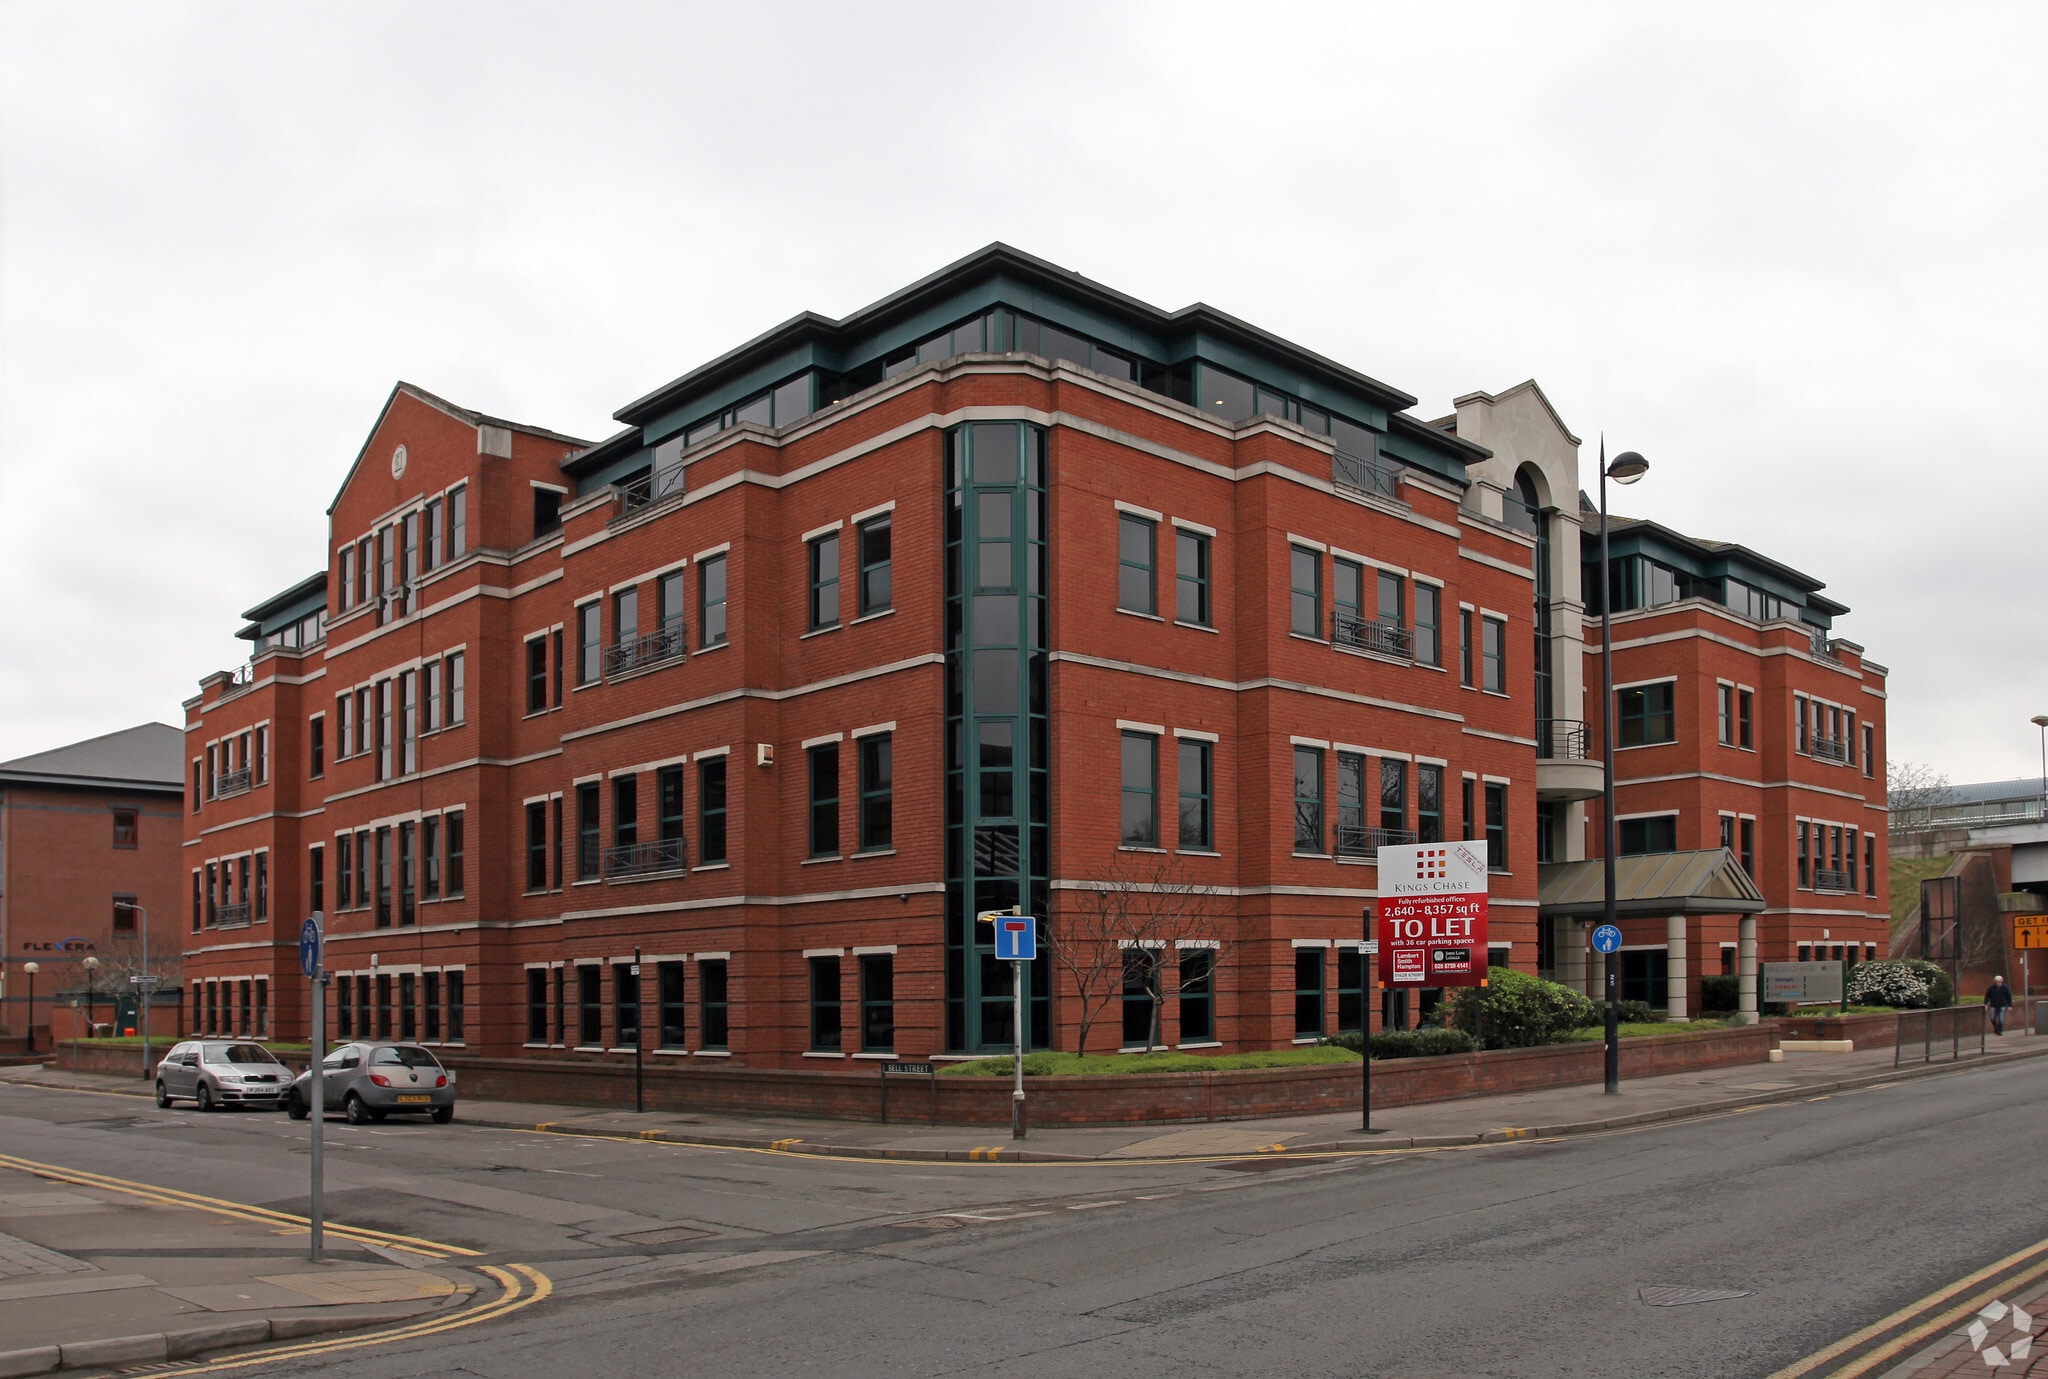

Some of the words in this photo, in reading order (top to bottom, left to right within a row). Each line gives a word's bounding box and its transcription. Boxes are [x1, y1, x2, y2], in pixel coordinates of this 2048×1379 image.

[1456, 846, 1484, 873] TESLA
[1395, 883, 1428, 893] KINGS
[1433, 881, 1470, 890] CHASE
[1384, 906, 1415, 917] 2,640
[1424, 904, 1454, 916] 8,357
[1455, 905, 1468, 915] sq
[1469, 903, 1480, 913] ft
[2018, 917, 2038, 925] GET
[1389, 918, 1424, 938] TO
[1431, 917, 1476, 937] LET
[22, 940, 96, 953] FLEXERA
[1427, 938, 1452, 946] parking
[888, 1064, 902, 1072] BELL
[904, 1064, 929, 1073] STREET
